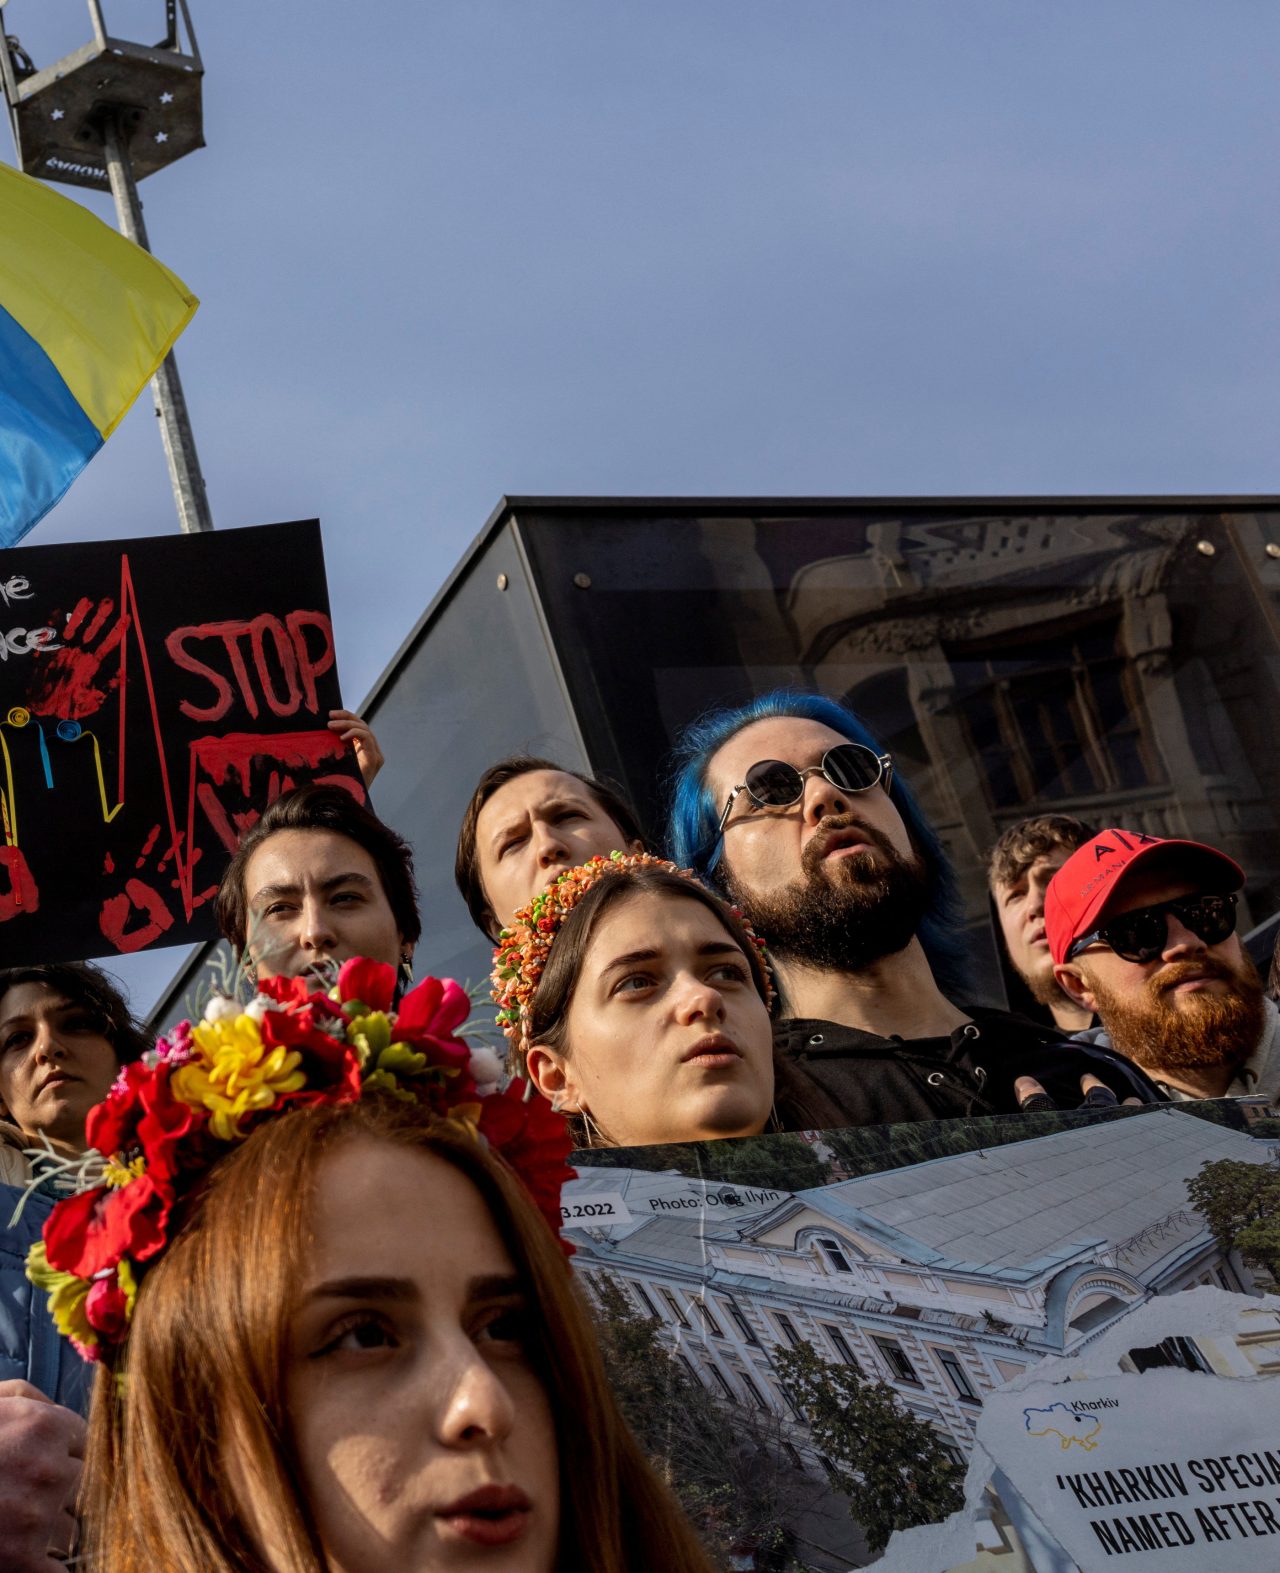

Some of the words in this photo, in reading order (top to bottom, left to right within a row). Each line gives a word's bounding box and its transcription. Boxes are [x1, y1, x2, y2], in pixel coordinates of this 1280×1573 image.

[164, 609, 336, 722] STOP
[649, 1197, 703, 1211] Photo:
[706, 1193, 744, 1206] Olg
[745, 1189, 780, 1205] Ilyin
[1071, 1398, 1119, 1413] Kharkiv
[1187, 1450, 1280, 1493] SPECIA
[1090, 1511, 1195, 1555] NAMED
[1194, 1500, 1280, 1542] AFTER
